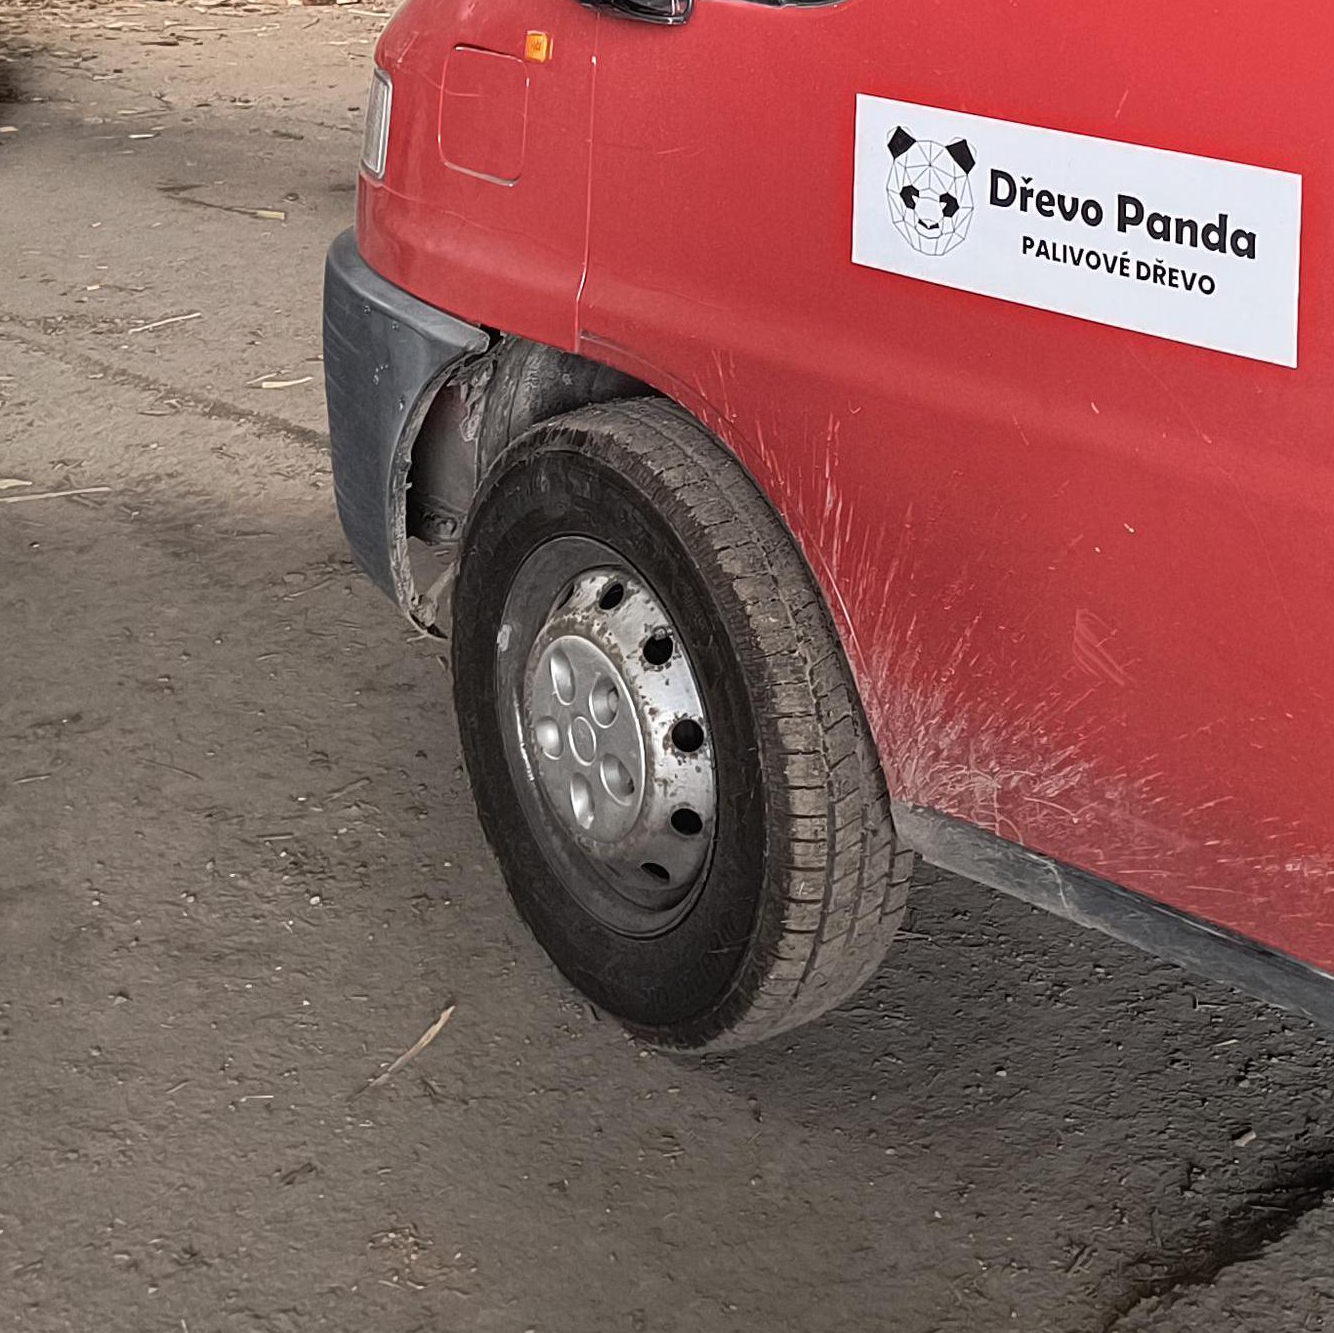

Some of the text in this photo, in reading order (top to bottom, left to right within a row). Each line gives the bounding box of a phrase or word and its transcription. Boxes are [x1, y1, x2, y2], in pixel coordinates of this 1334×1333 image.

[989, 168, 1257, 259] Dřevo Panda
[1022, 235, 1216, 295] PALIVOVÉ DŘEVO
